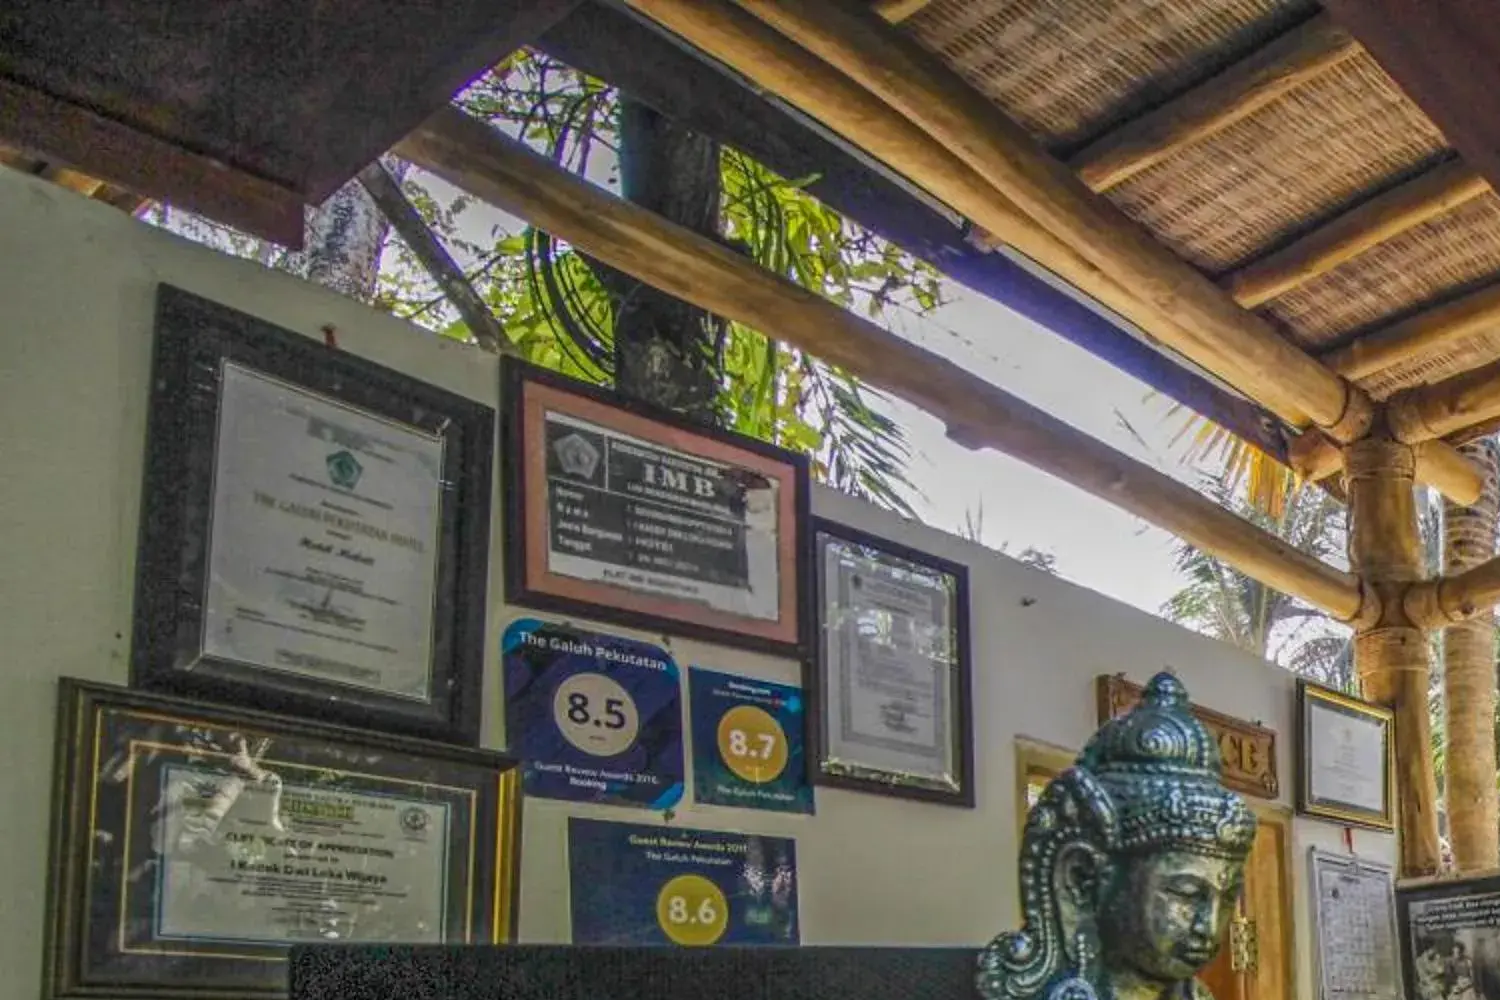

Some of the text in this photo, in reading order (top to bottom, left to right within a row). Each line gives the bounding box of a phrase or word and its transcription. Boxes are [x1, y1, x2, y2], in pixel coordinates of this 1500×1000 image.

[643, 463, 716, 497] IMB
[519, 631, 667, 671] The Galuh Pekutatan
[567, 693, 626, 729] 8.5
[729, 729, 776, 760] 8.7
[667, 895, 717, 924] 8.6
